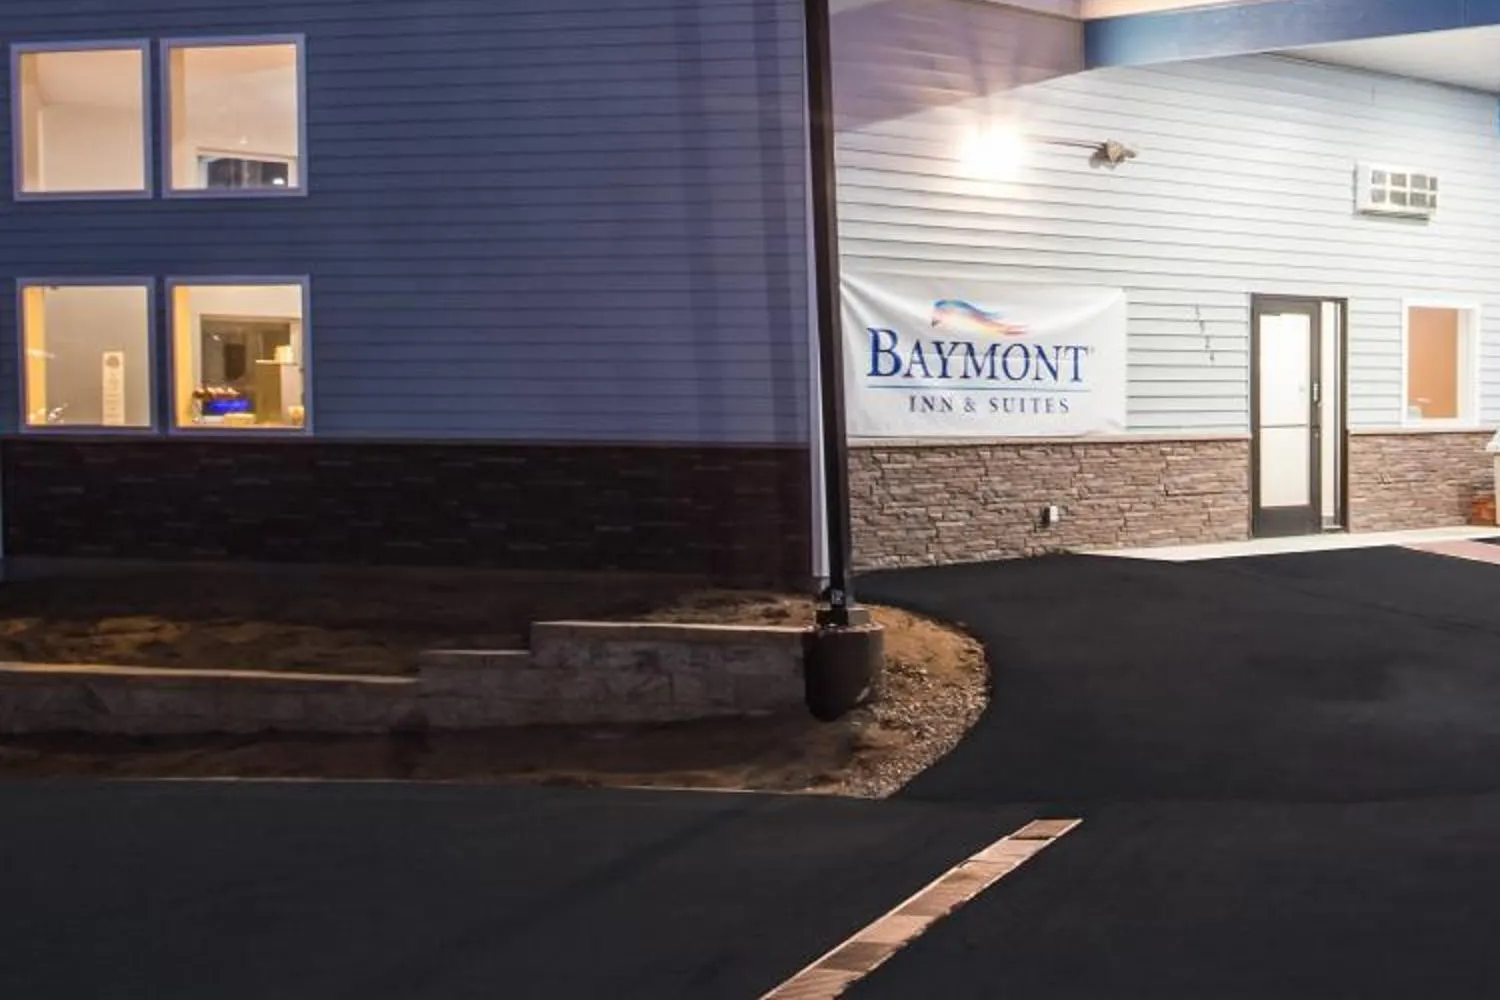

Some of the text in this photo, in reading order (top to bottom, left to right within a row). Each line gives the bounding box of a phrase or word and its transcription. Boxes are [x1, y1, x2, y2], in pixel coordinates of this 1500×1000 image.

[867, 327, 1089, 382] BAYMONT
[908, 394, 1070, 414] INN & SUITES
